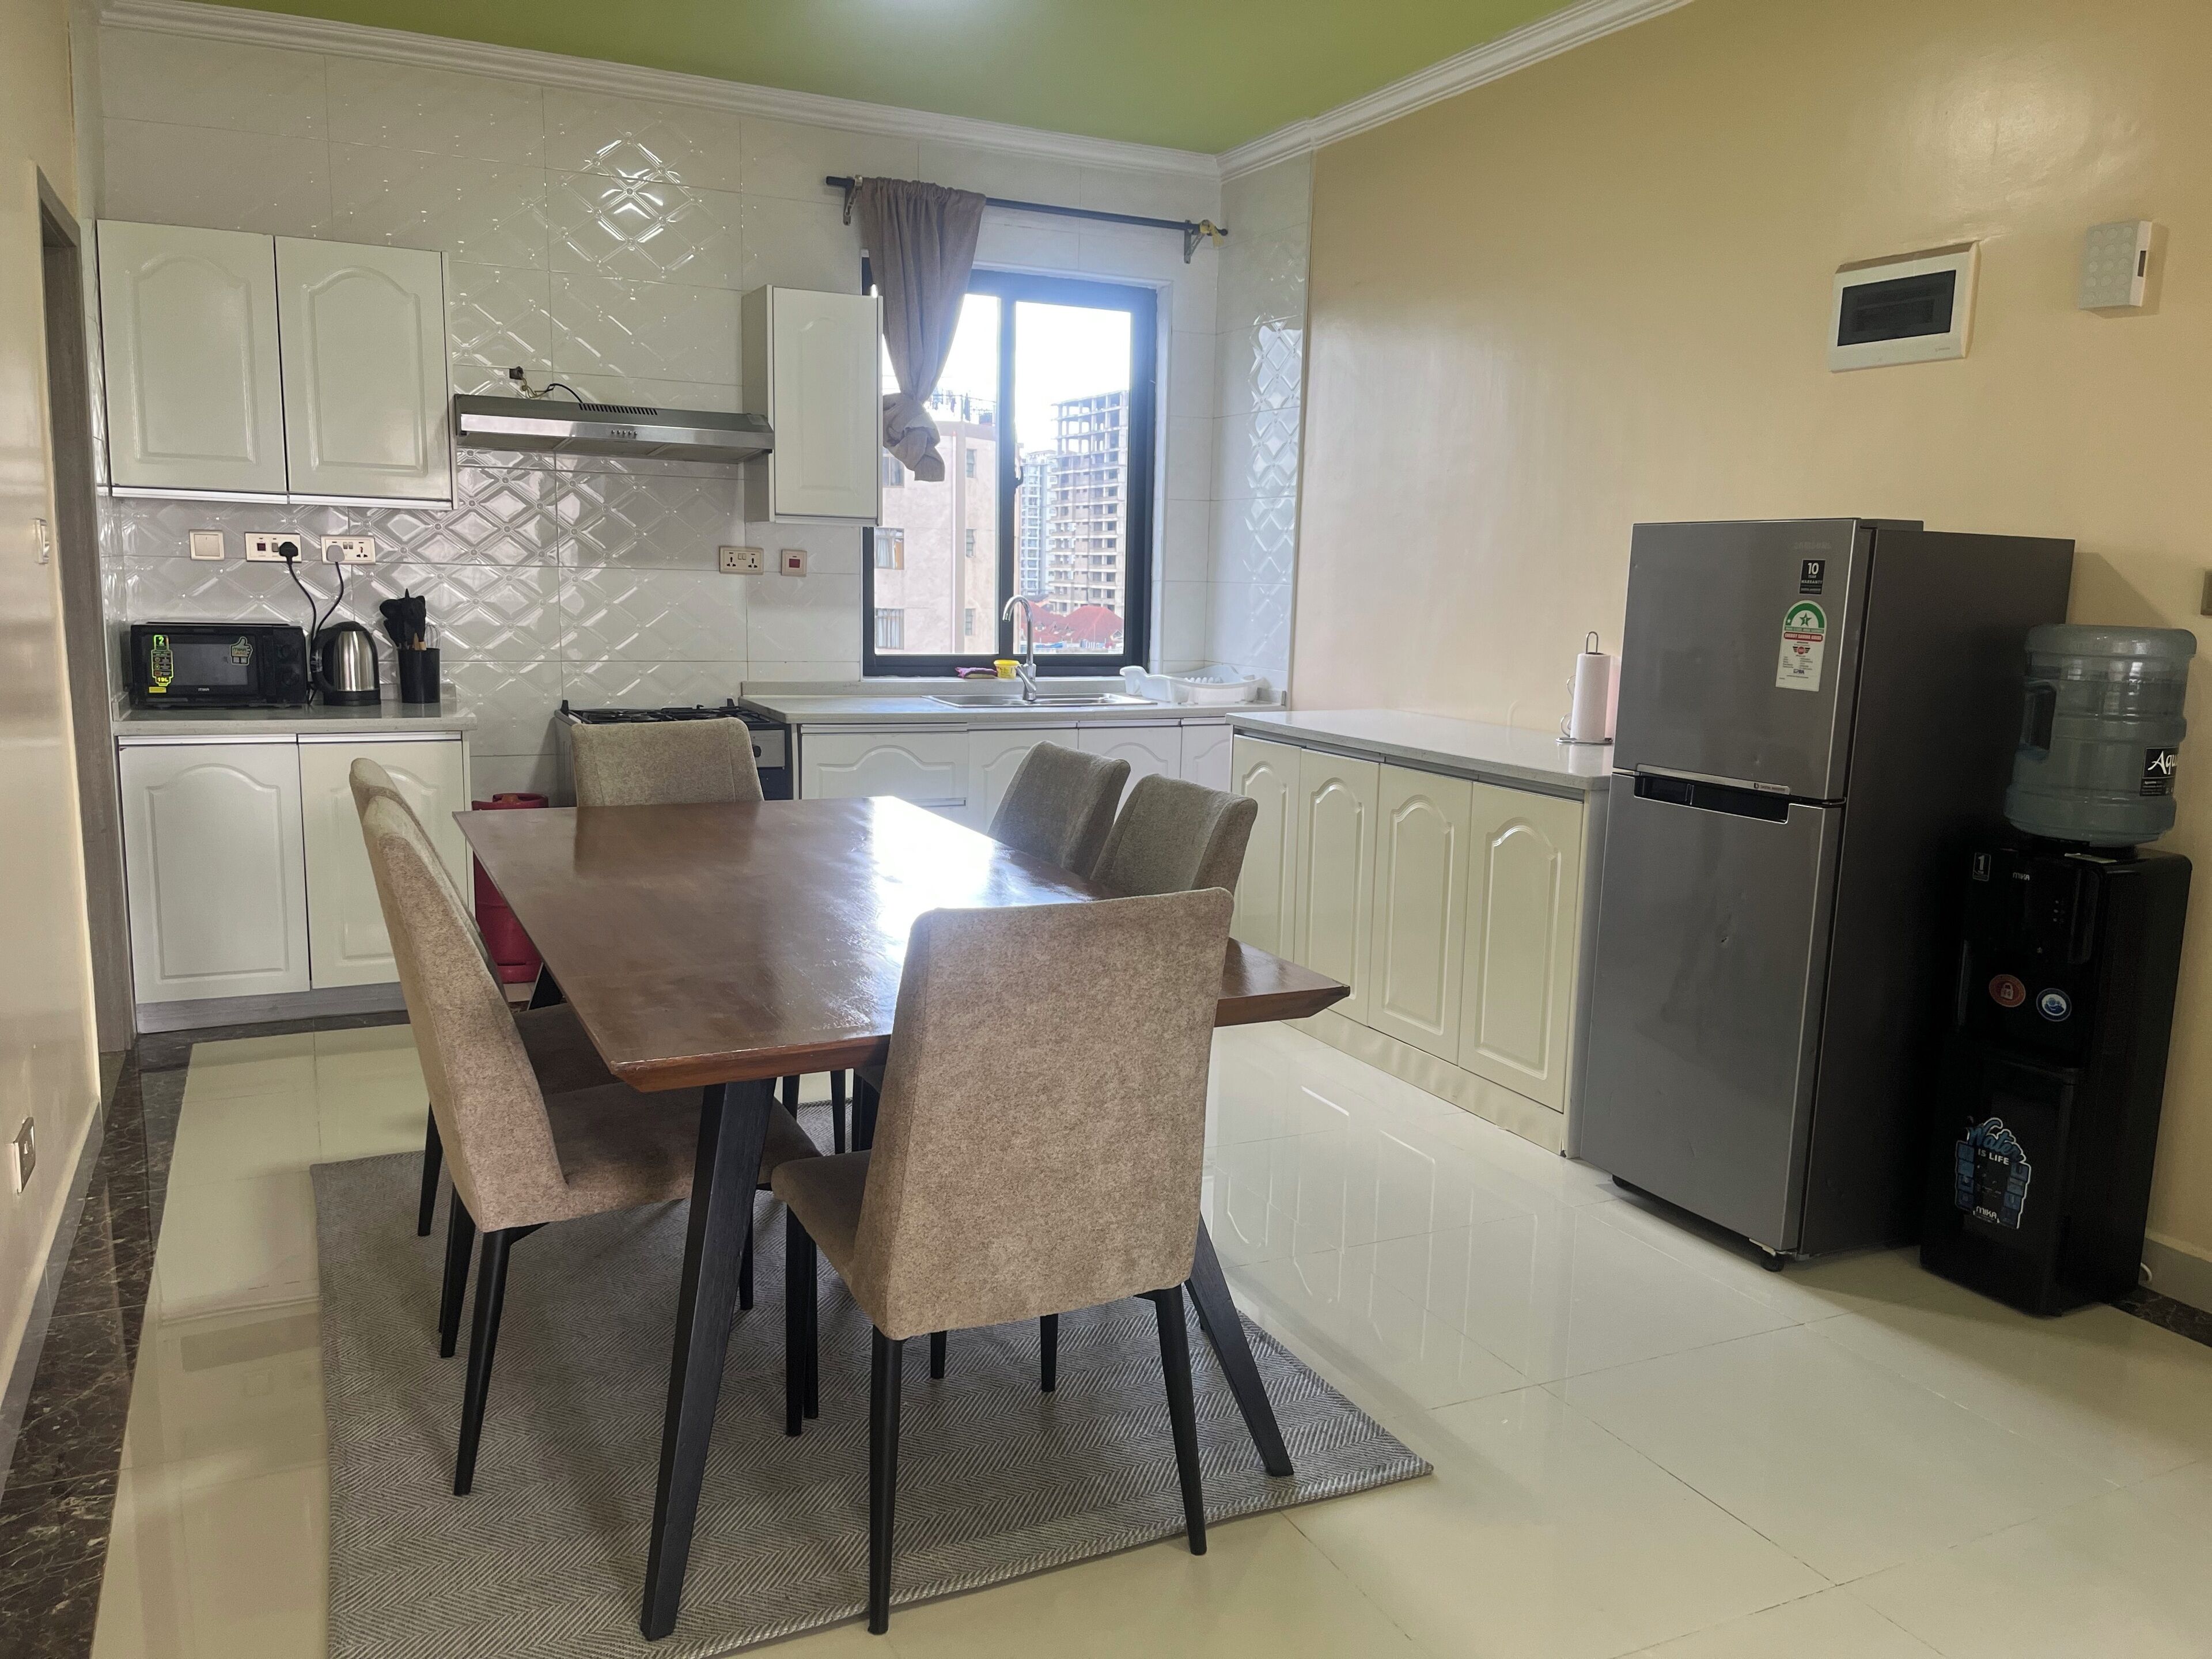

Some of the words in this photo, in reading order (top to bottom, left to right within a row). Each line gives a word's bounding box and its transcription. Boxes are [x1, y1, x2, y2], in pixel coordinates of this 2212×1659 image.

[1808, 562, 1819, 574] 10
[158, 636, 165, 646] 2
[1978, 855, 1985, 870] 1
[2013, 872, 2030, 881] MIKA
[1978, 1148, 1986, 1157] IS
[1989, 1152, 2009, 1165] LIFE
[1976, 1205, 1998, 1219] MIKA
